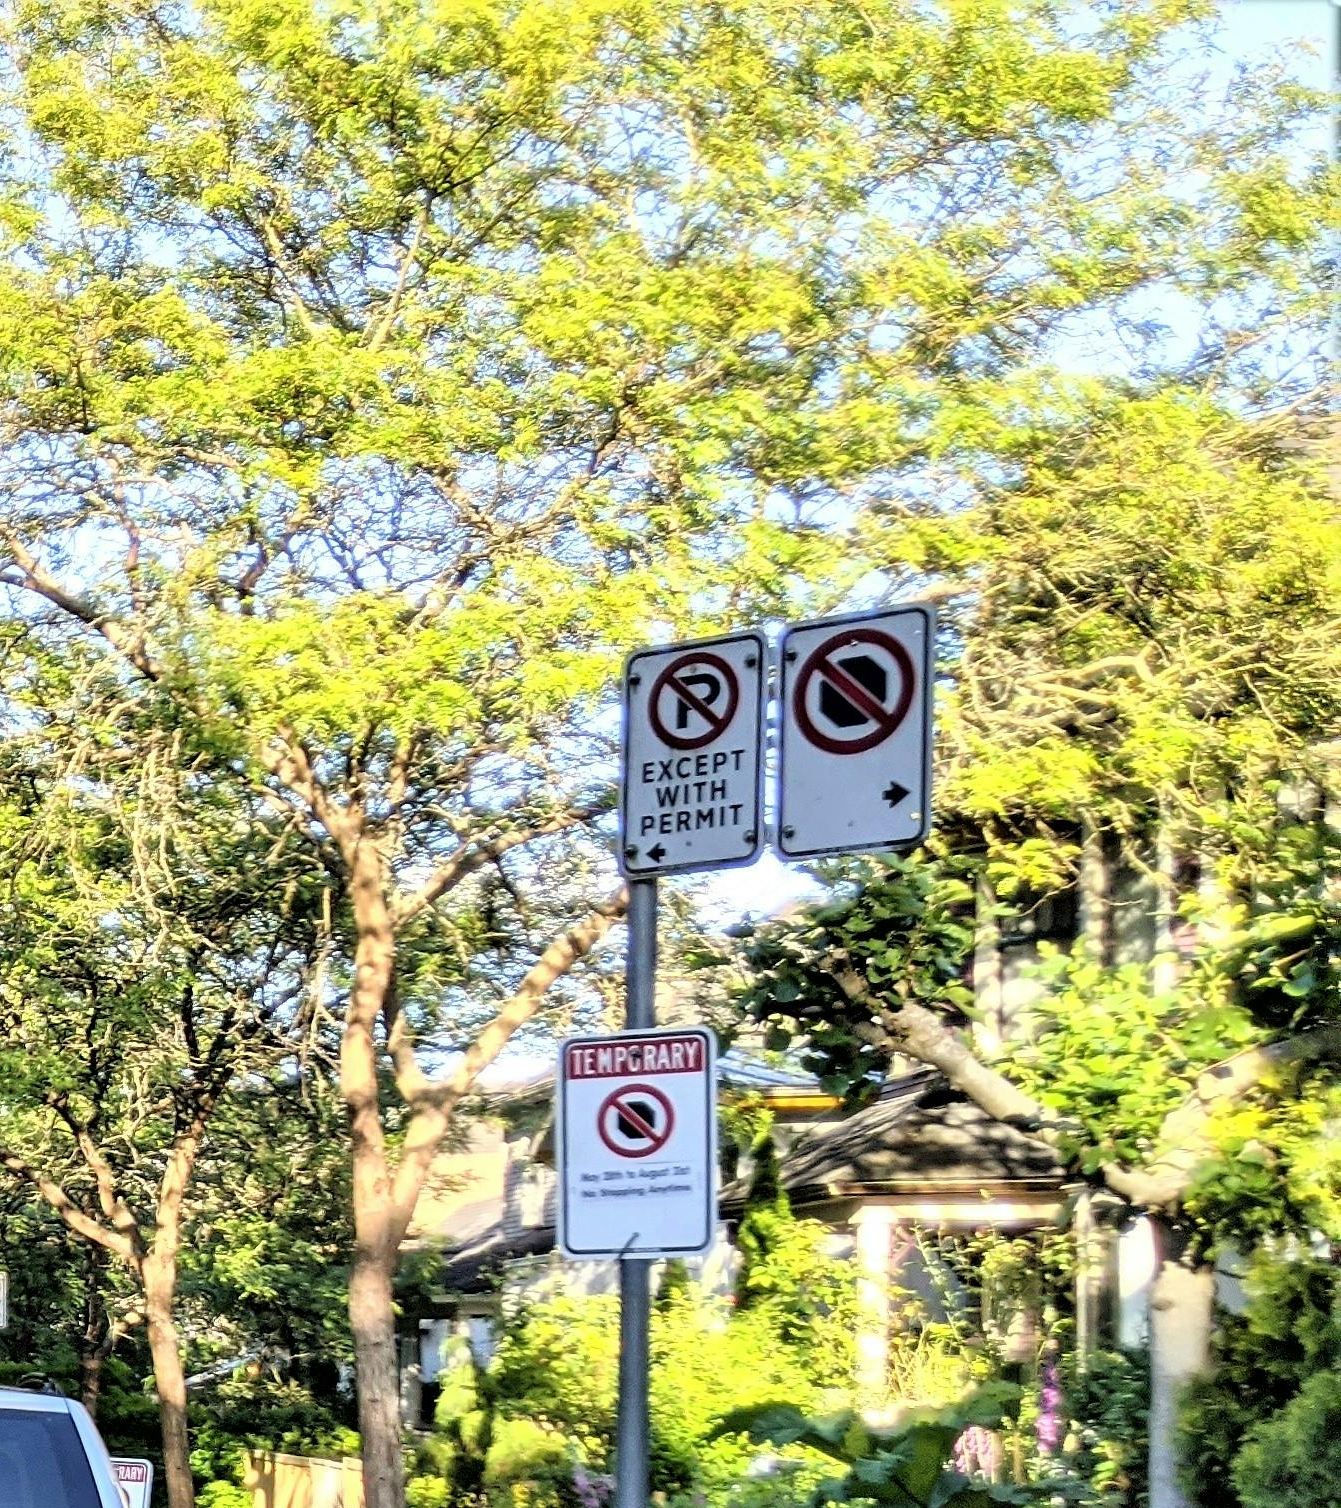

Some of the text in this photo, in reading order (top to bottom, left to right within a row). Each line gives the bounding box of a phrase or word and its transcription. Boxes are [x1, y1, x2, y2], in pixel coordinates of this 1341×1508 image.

[643, 750, 745, 783] EXCEPT
[656, 780, 727, 808] WITH
[640, 804, 744, 837] PERMIT
[571, 1041, 699, 1075] TEMPORARY
